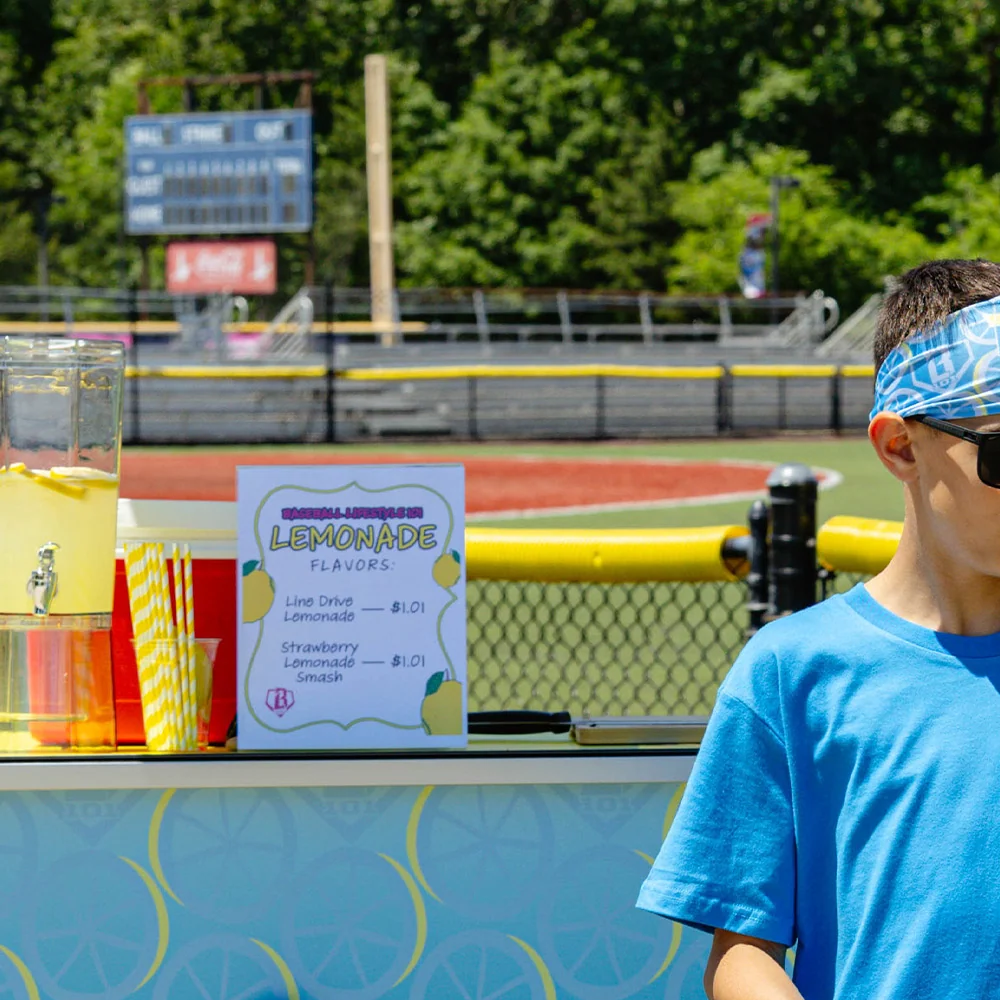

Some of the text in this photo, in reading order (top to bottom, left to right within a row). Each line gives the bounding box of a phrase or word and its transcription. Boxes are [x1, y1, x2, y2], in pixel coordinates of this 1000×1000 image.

[282, 507, 341, 520] BASEBALL
[346, 507, 406, 520] LIFESTYLE
[270, 522, 437, 553] LEMONADE
[311, 558, 395, 572] FLAVORS:
[286, 595, 353, 607] Line Drive
[390, 601, 425, 614] $1.01
[284, 610, 355, 622] Lemonade
[281, 641, 359, 656] Strawberry
[284, 654, 425, 669] Lemonade $1.01
[296, 671, 343, 683] Smash
